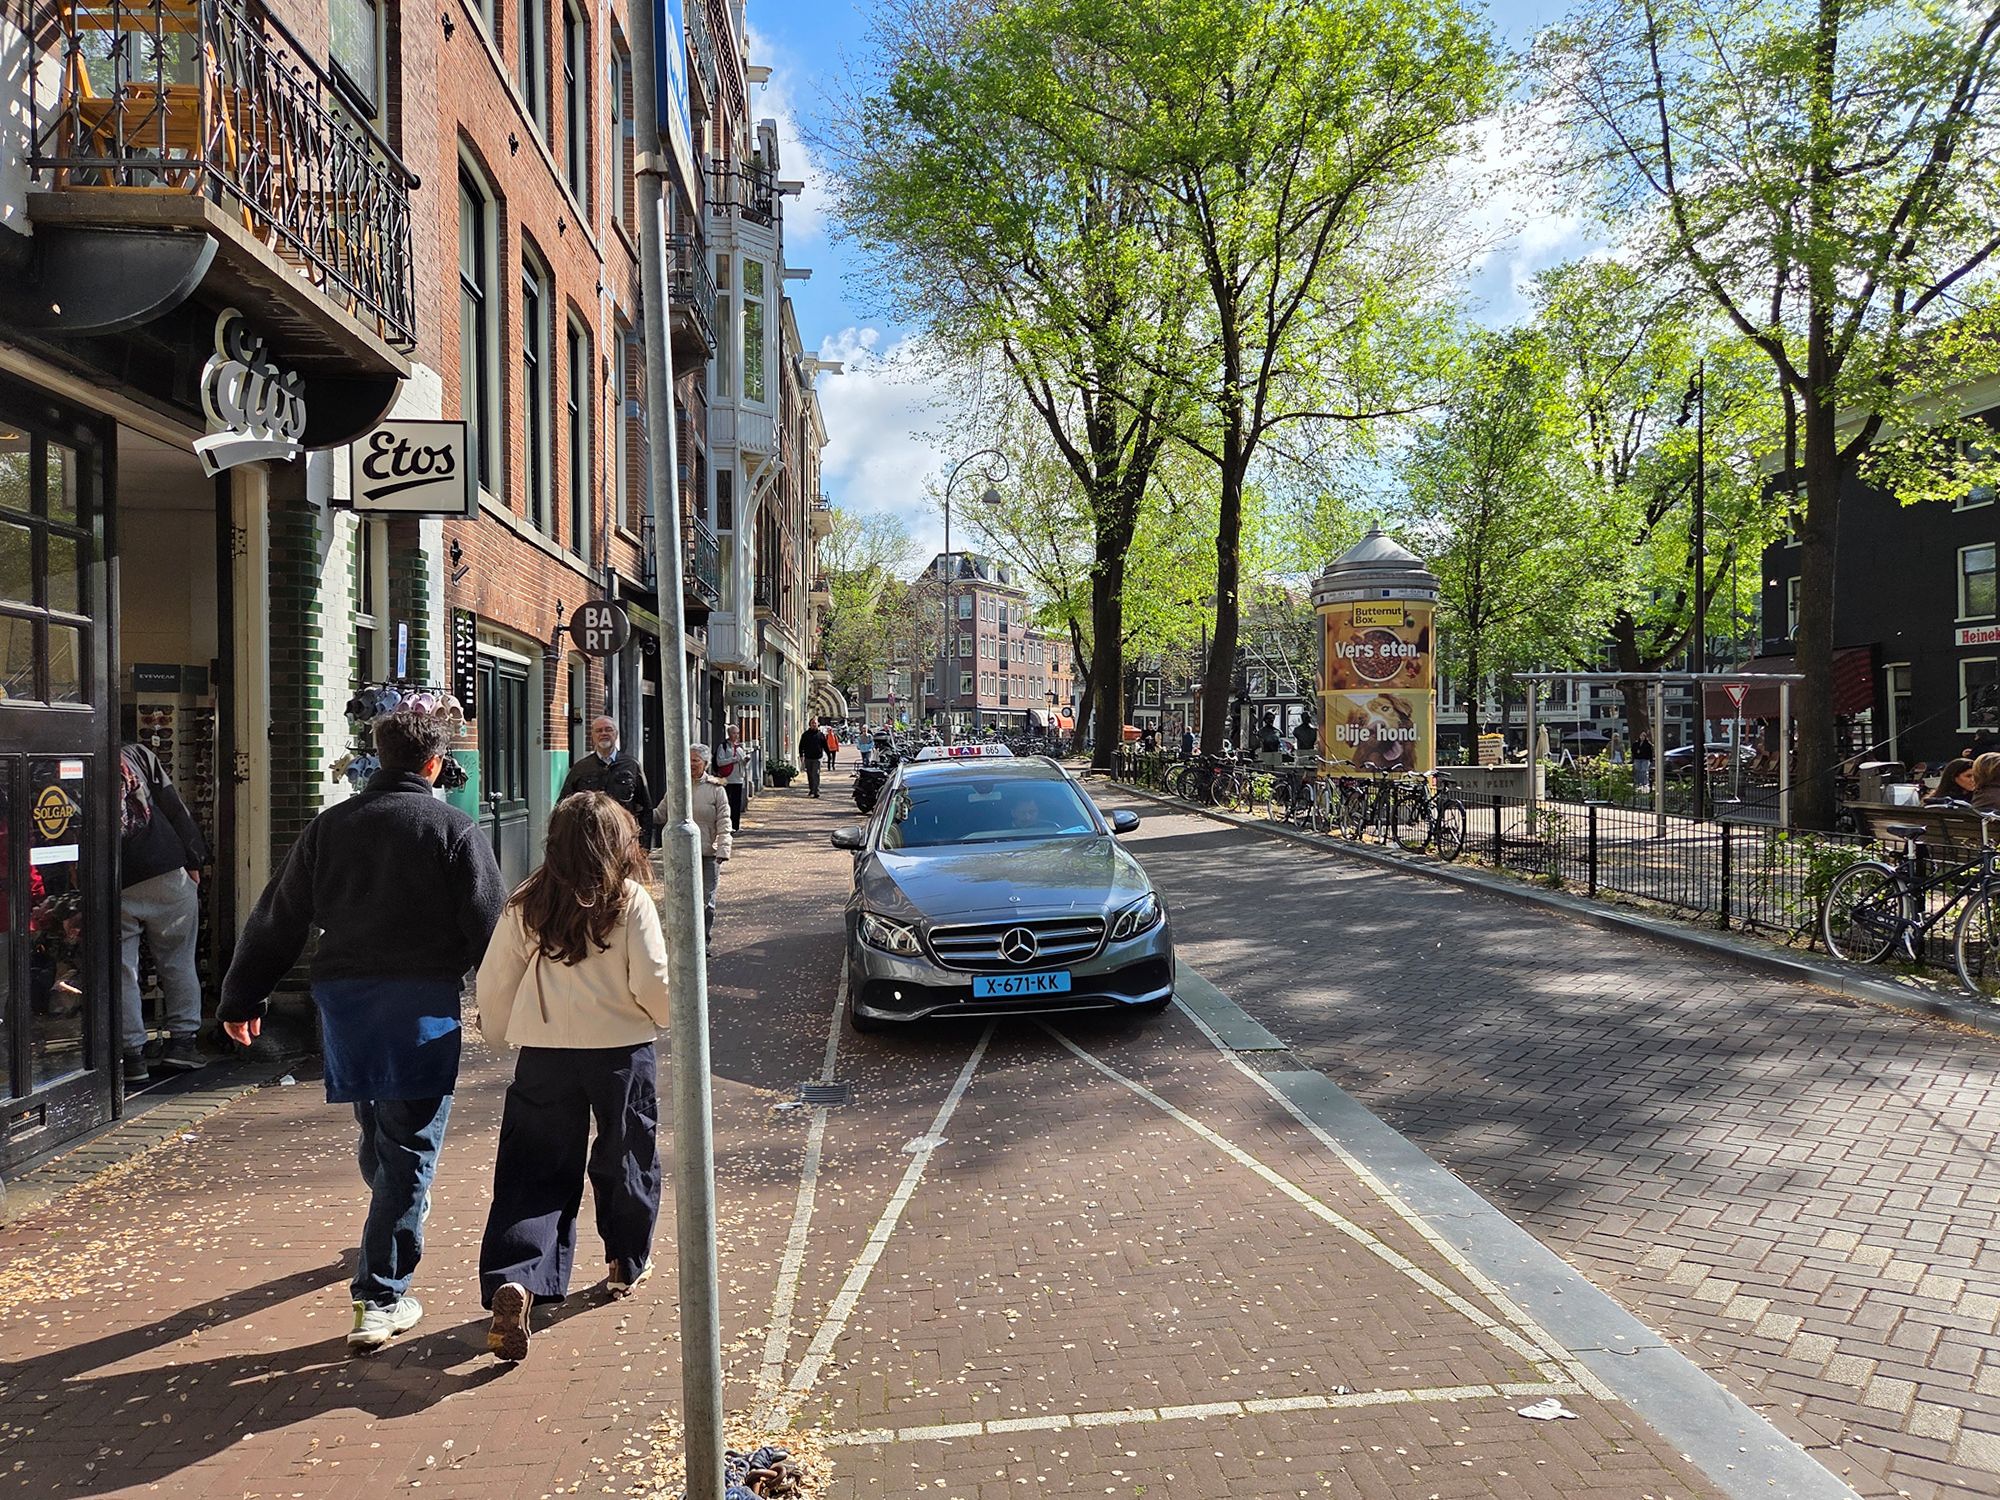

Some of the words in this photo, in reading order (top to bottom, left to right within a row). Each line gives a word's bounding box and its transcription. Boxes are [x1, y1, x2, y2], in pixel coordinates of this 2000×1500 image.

[362, 430, 455, 480] Etos
[585, 607, 613, 628] BA
[1355, 607, 1402, 616] Butternut
[1355, 616, 1377, 624] Box.
[585, 629, 613, 650] RT
[1335, 641, 1374, 658] Vers
[1380, 641, 1420, 658] eten.
[1335, 723, 1370, 746] Blije
[1376, 723, 1421, 741] hond.
[985, 745, 999, 755] 665
[33, 805, 73, 820] SOLGAR
[986, 974, 1059, 994] X-671-KK
